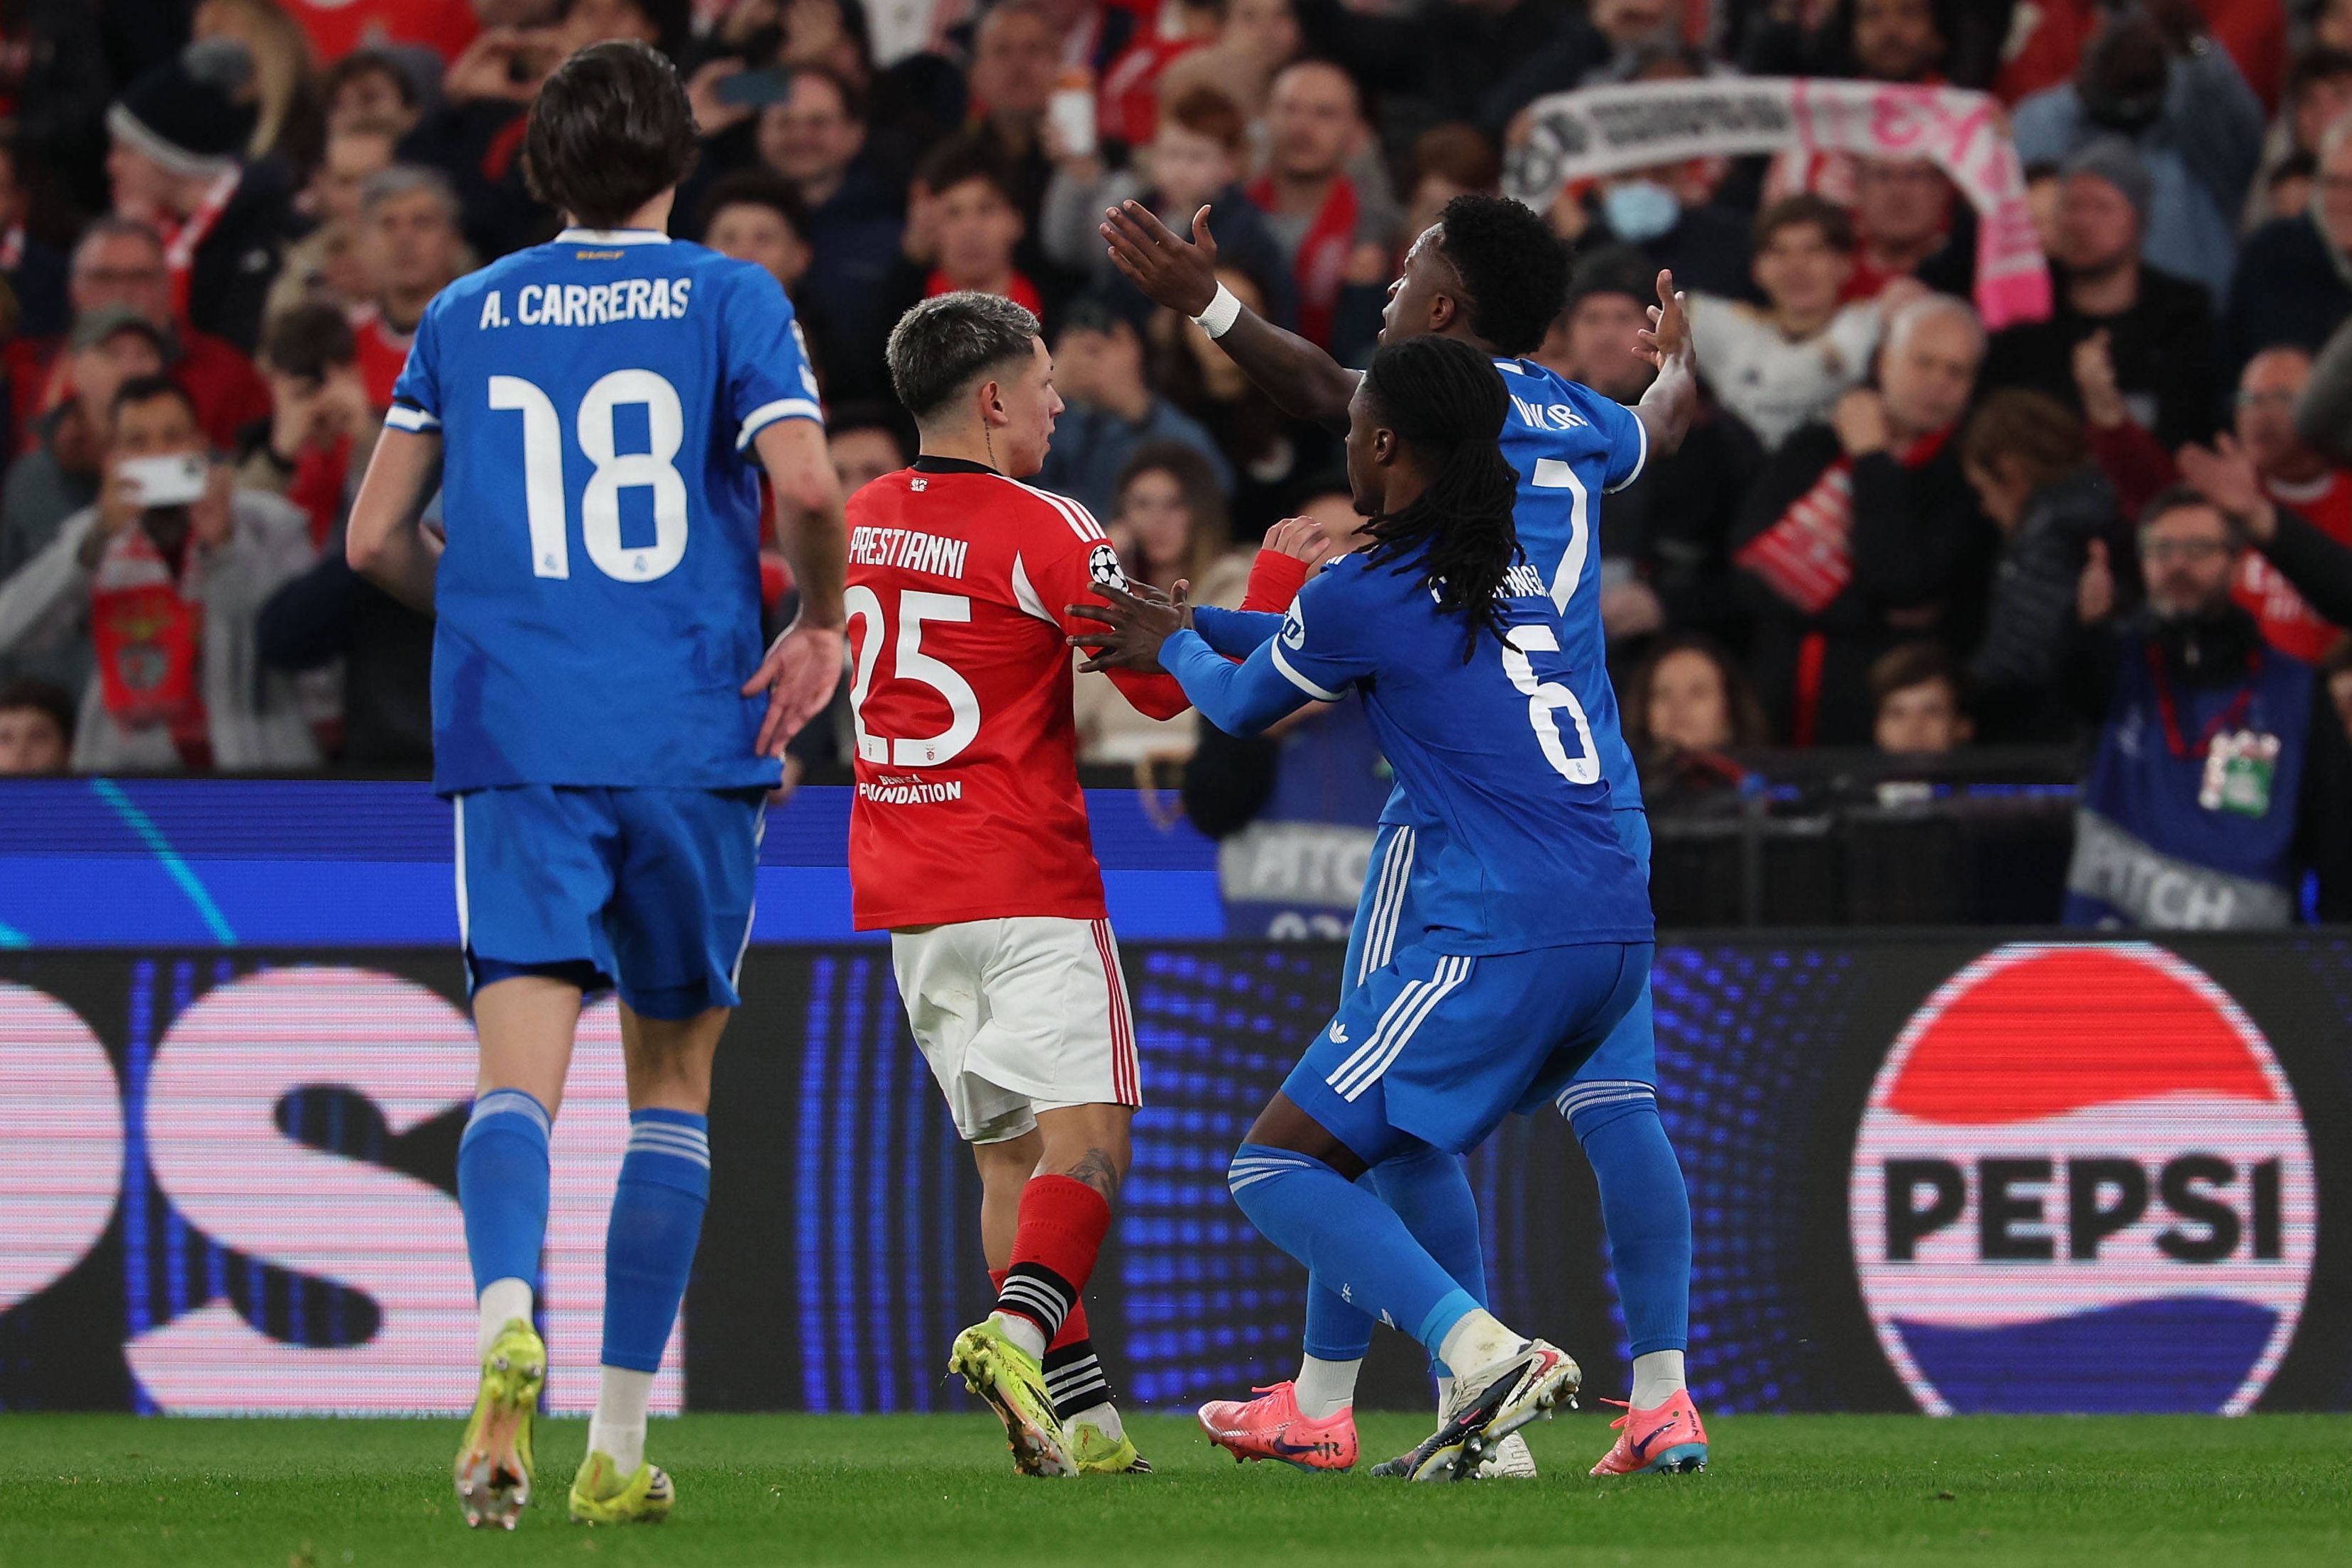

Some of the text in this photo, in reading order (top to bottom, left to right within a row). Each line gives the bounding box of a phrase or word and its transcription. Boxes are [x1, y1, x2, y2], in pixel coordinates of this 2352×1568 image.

[480, 278, 691, 329] A. CARRERAS
[488, 368, 689, 583] 18
[848, 526, 968, 579] PRESTIANNI
[1532, 458, 1588, 617] 7
[842, 585, 981, 767] 25
[1502, 625, 1600, 785] 6
[1884, 1154, 2281, 1263] PEPSI
